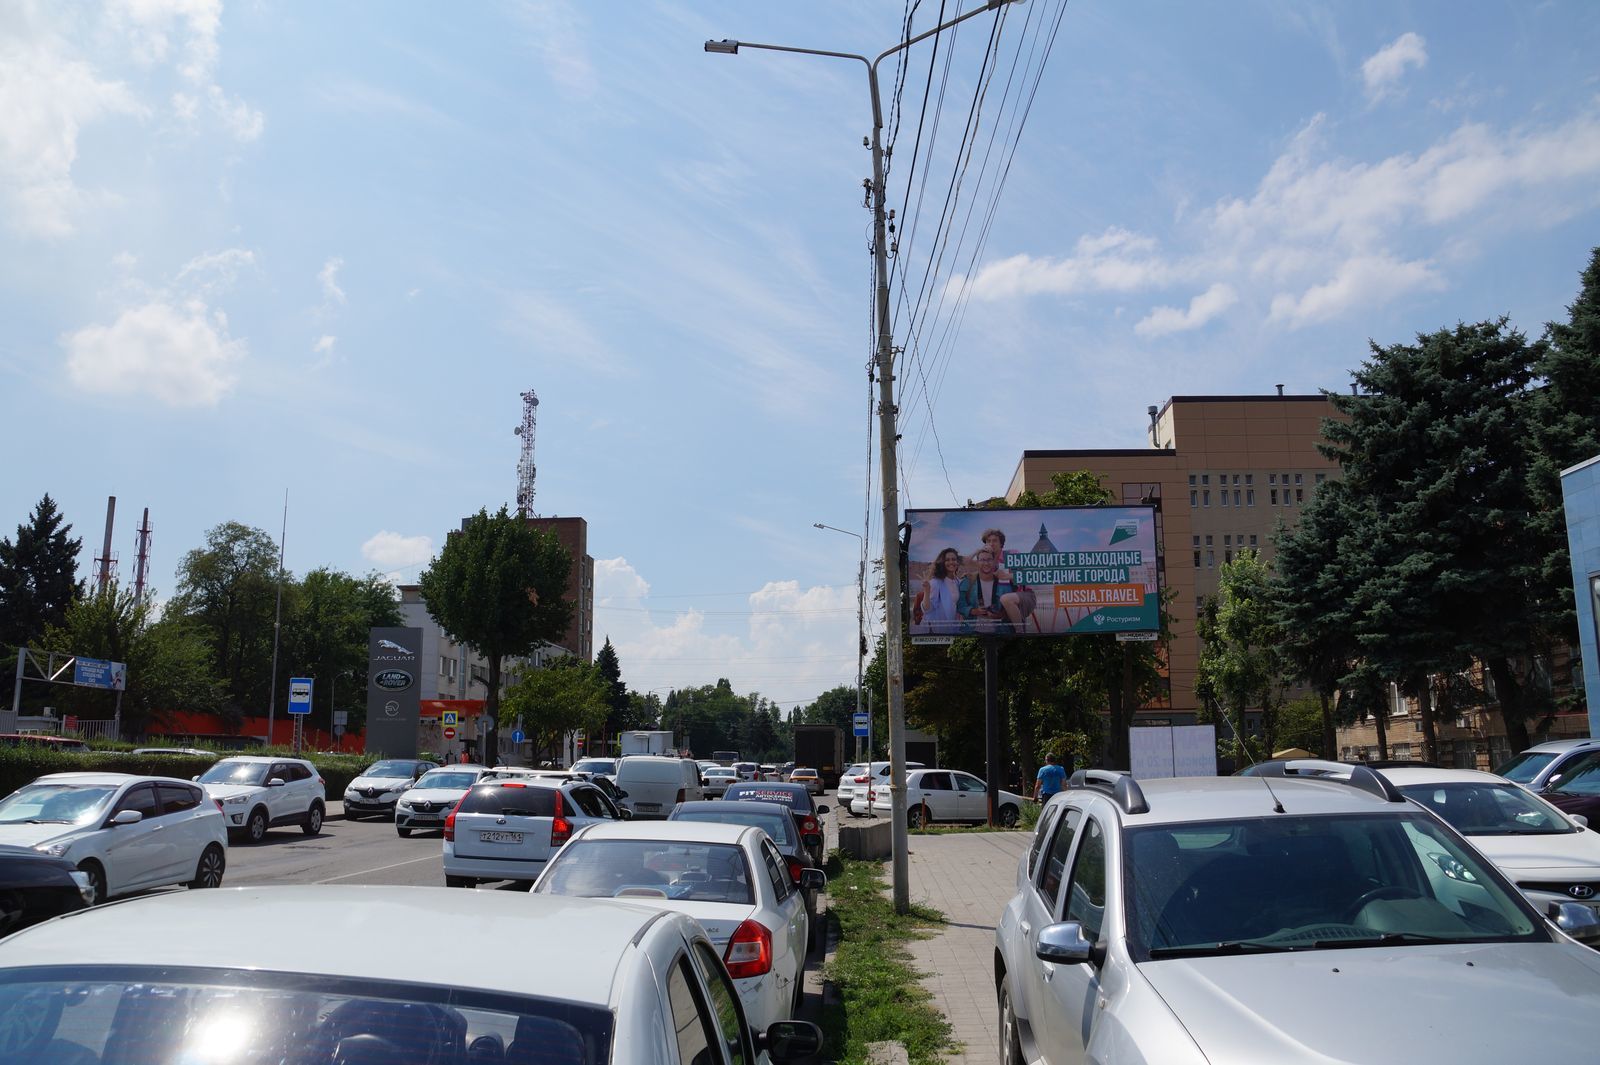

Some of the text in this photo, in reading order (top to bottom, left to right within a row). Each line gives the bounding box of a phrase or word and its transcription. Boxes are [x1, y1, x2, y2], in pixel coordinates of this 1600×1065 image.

[1007, 551, 1141, 567] ВЫХОДИТЕ В ВЫХОДНЫЕ
[1016, 569, 1126, 584] В СОСЕДНИЕ ГОРОДА
[1059, 588, 1139, 603] RUSSIA.TRAVEL
[1106, 615, 1141, 624] Ростуризм
[383, 679, 406, 687] ROVER
